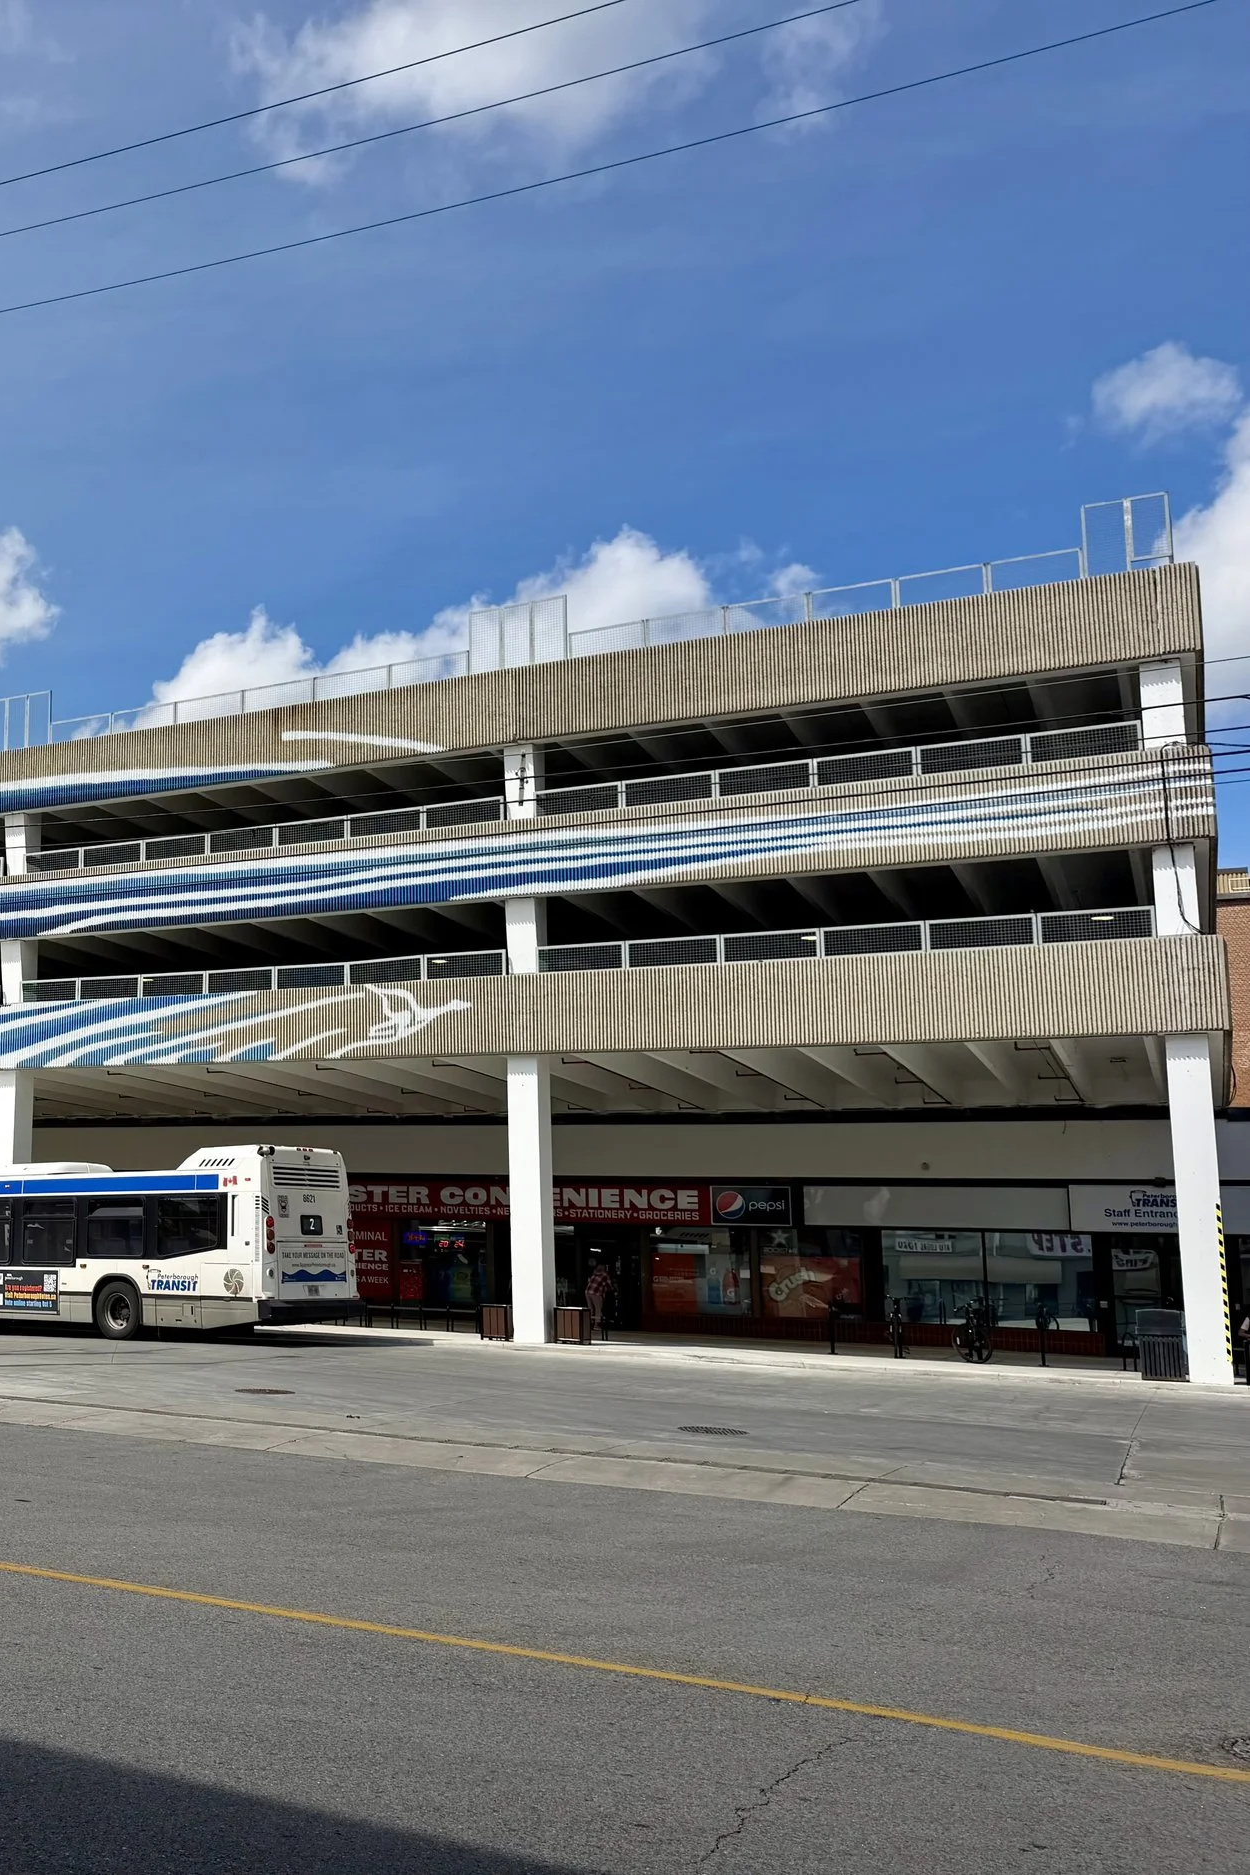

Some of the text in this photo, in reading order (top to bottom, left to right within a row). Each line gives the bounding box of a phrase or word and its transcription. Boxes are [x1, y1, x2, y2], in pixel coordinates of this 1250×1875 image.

[303, 1194, 316, 1203] 8621
[348, 1185, 429, 1203] STER
[749, 1200, 784, 1212] pepsi
[1134, 1199, 1177, 1207] TRANS
[402, 1205, 432, 1213] CREAM
[440, 1206, 490, 1215] NOVELTIES
[570, 1209, 632, 1219] STATIONERY
[639, 1211, 699, 1220] GROCERIES
[1104, 1208, 1178, 1218] Staff Entranc
[310, 1219, 315, 1230] 2
[355, 1231, 388, 1241] MINAL
[355, 1249, 387, 1261] TER
[157, 1273, 198, 1282] Peterborough
[151, 1280, 198, 1291] TRANSIT
